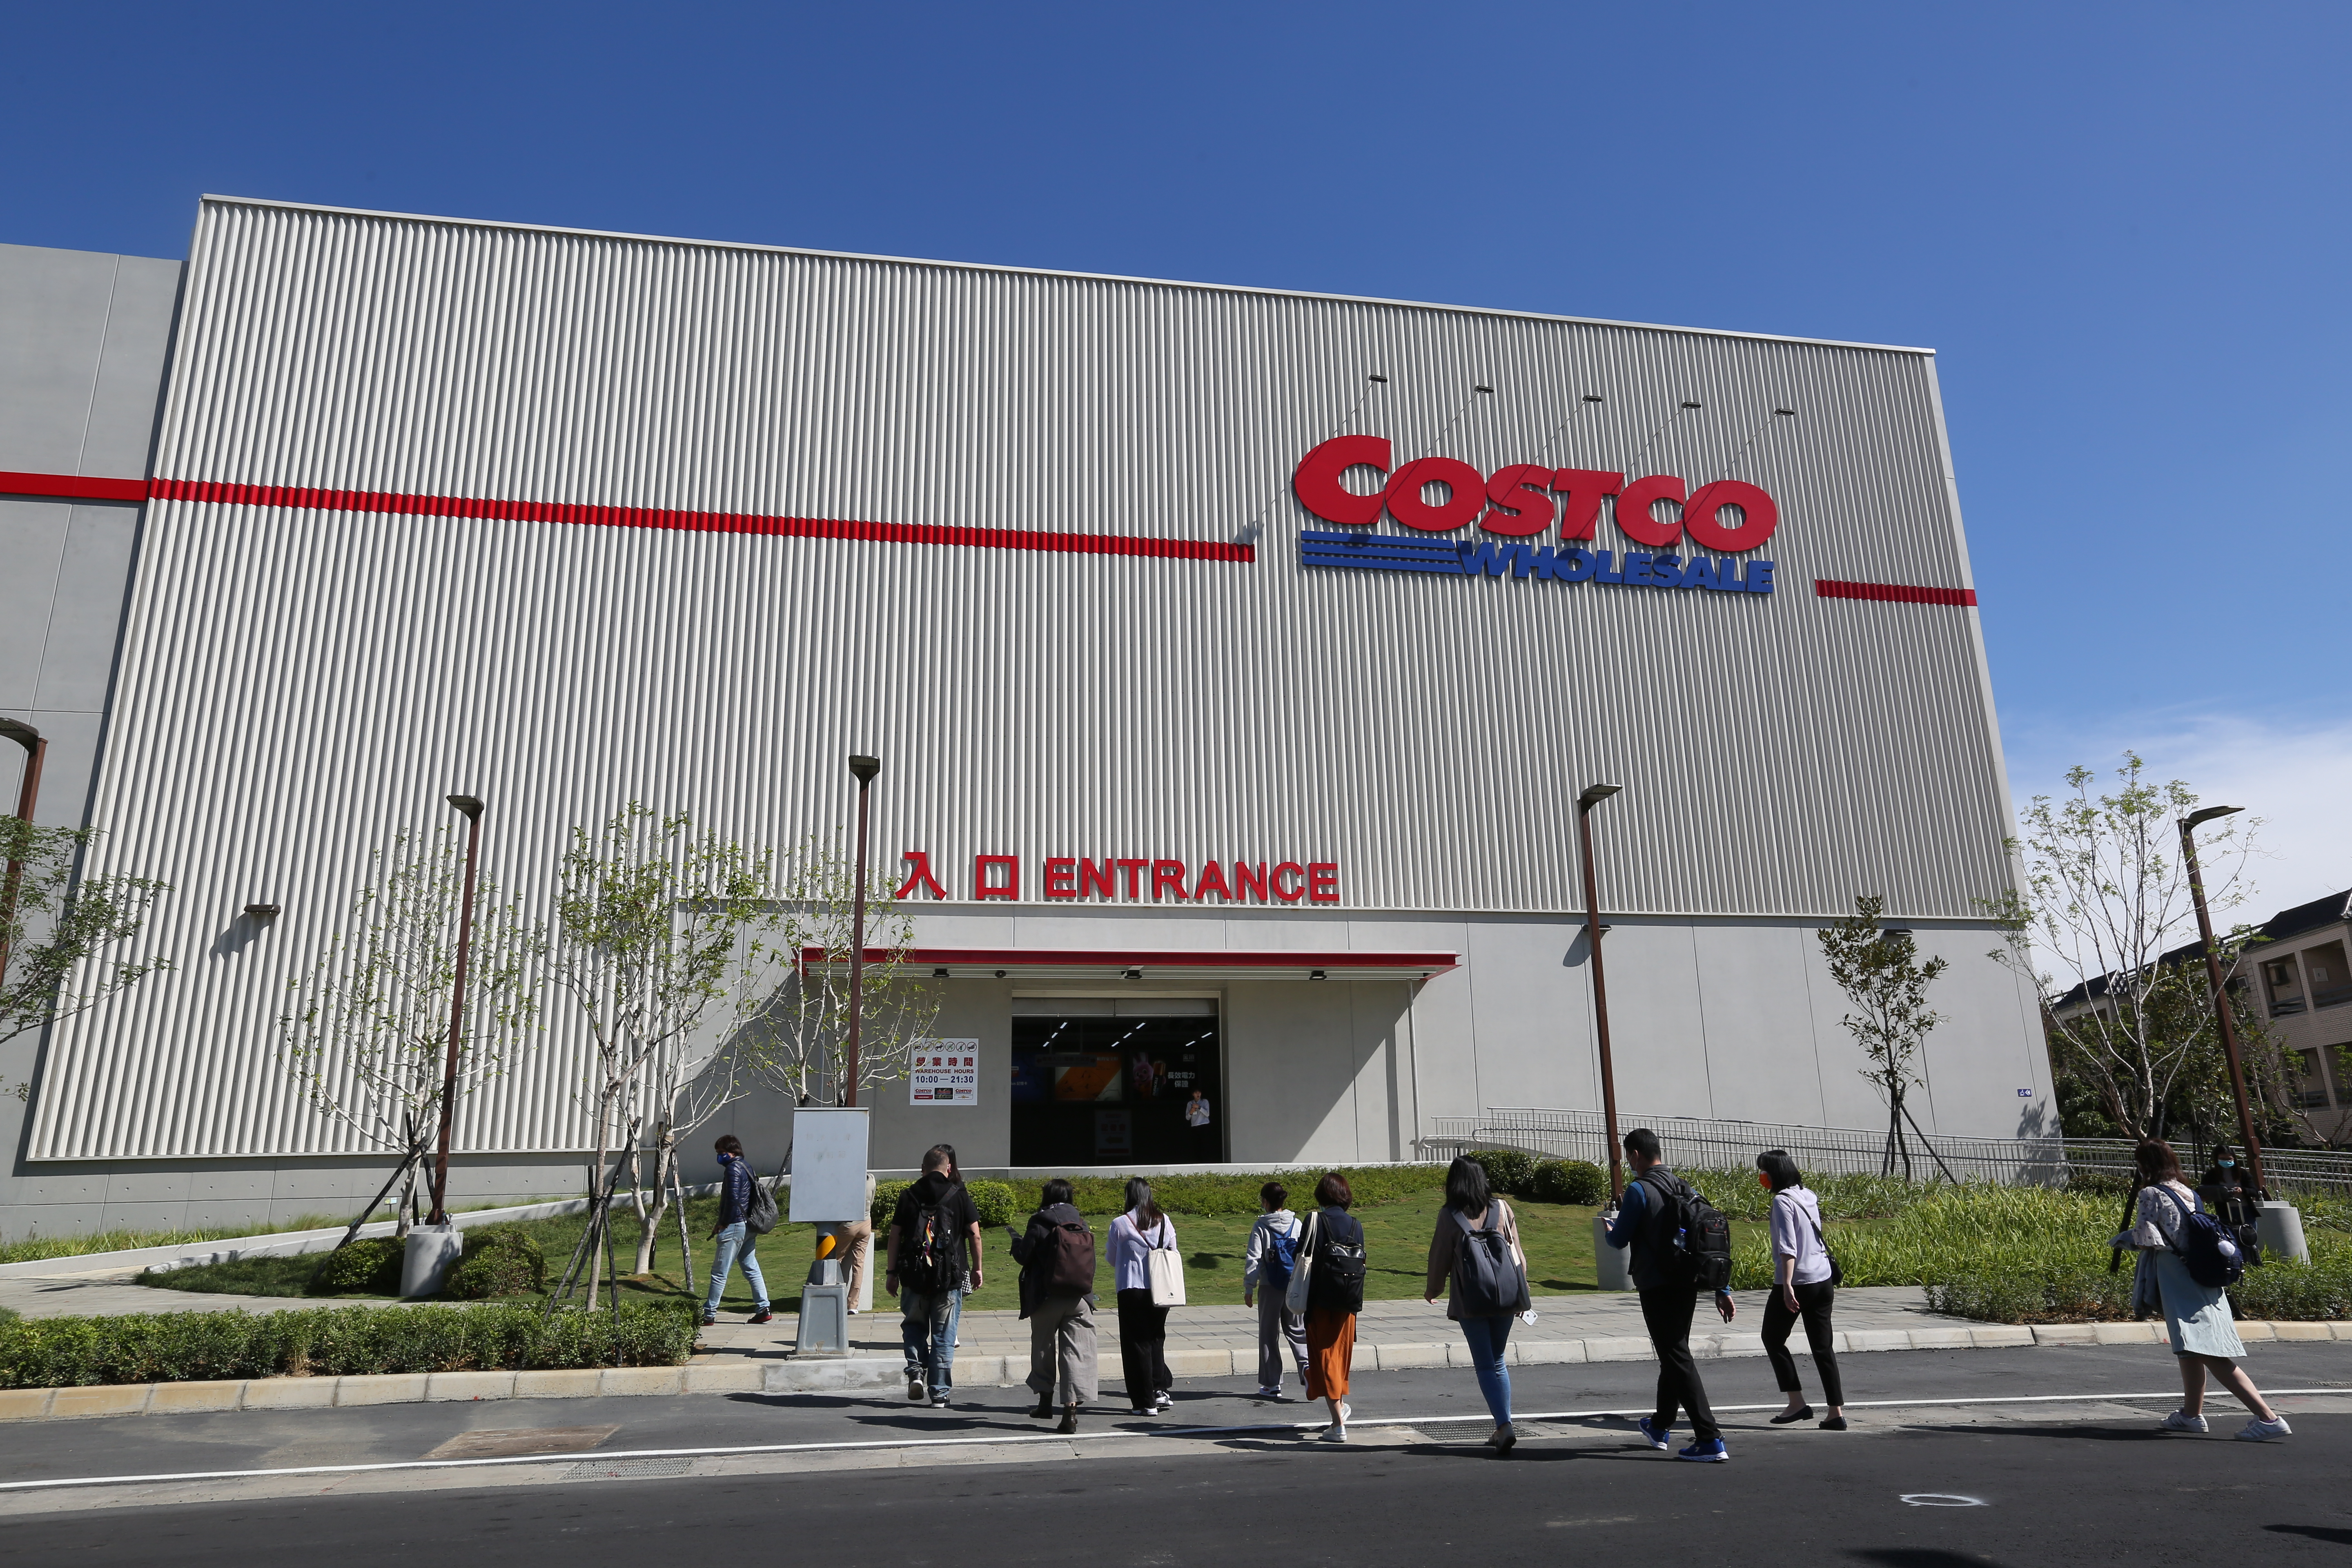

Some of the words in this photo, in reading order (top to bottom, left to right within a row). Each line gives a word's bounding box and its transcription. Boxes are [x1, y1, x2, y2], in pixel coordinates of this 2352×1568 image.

[1294, 434, 1777, 552] COSTCO
[1457, 540, 1774, 594] WHOLESALE
[895, 851, 1018, 900] 入口
[1045, 857, 1340, 902] ENTRANCE
[916, 1057, 973, 1067] 營業時間
